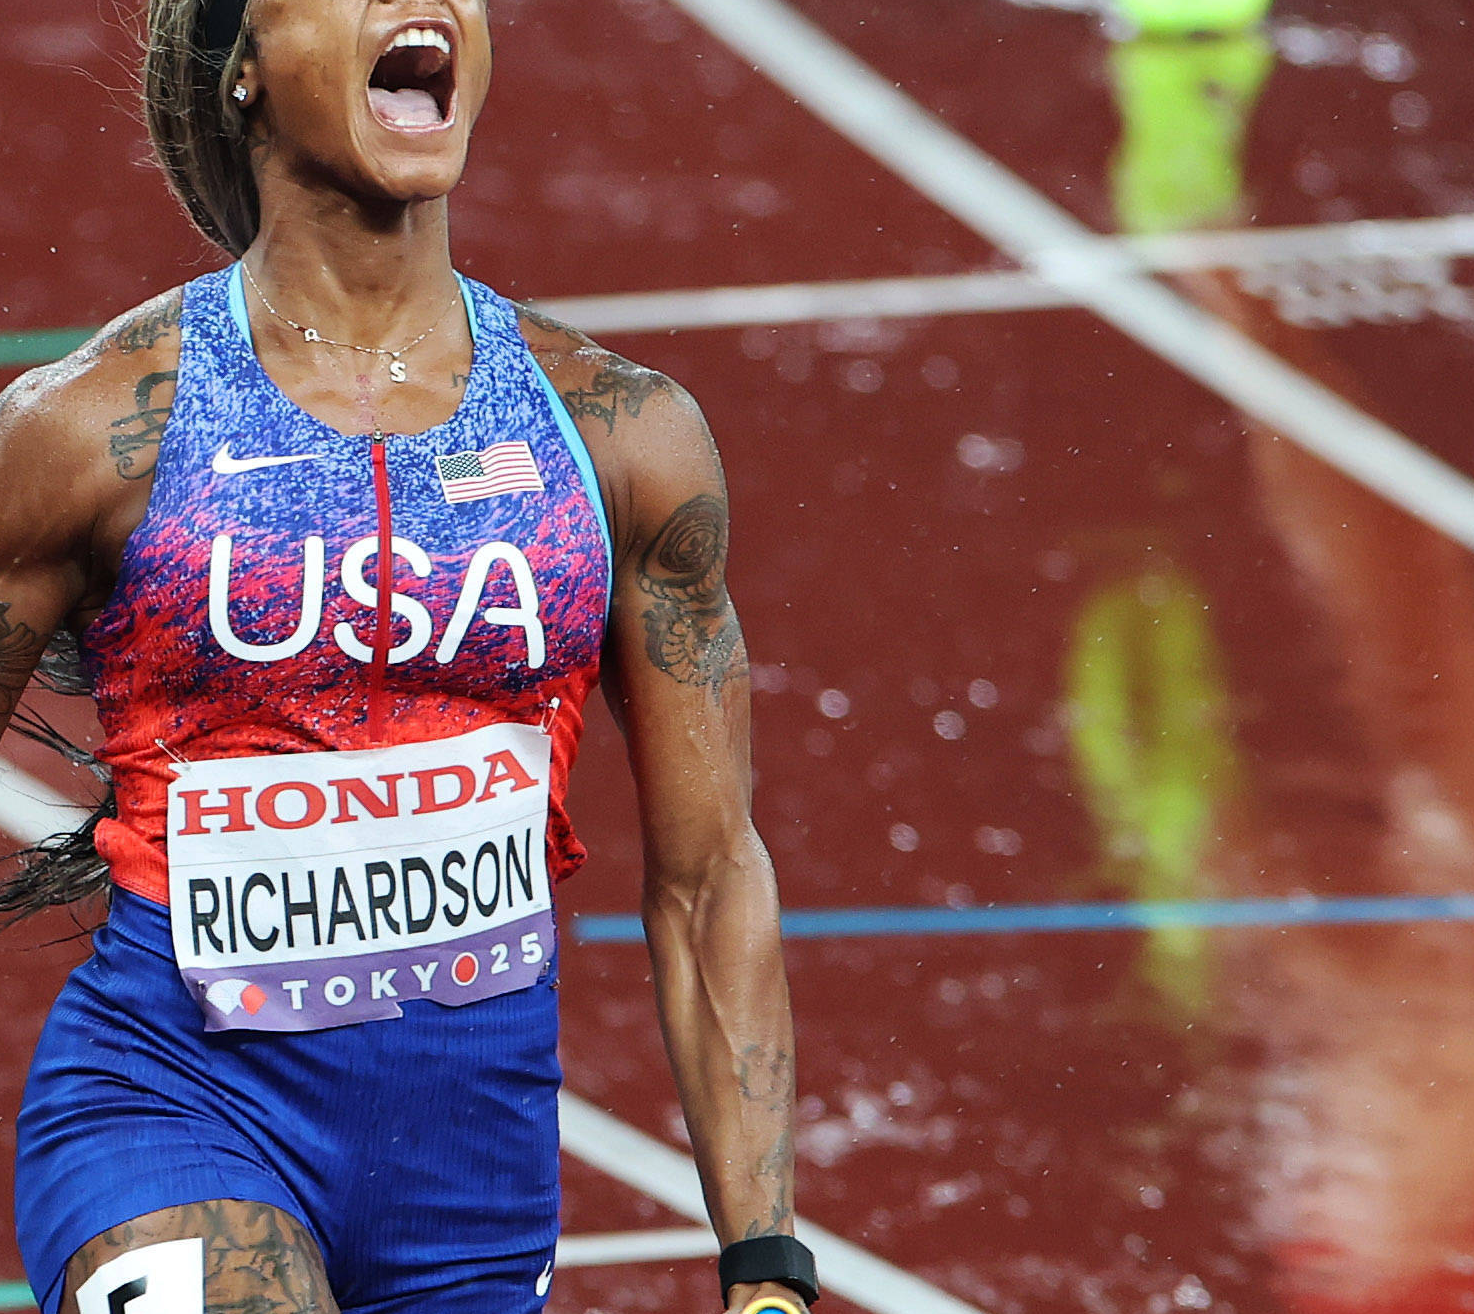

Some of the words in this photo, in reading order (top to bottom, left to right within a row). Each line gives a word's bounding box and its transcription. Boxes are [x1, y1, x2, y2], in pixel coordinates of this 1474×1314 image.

[208, 534, 546, 669] USA
[177, 749, 539, 835] HONDA
[188, 828, 534, 956] RICHARDSON
